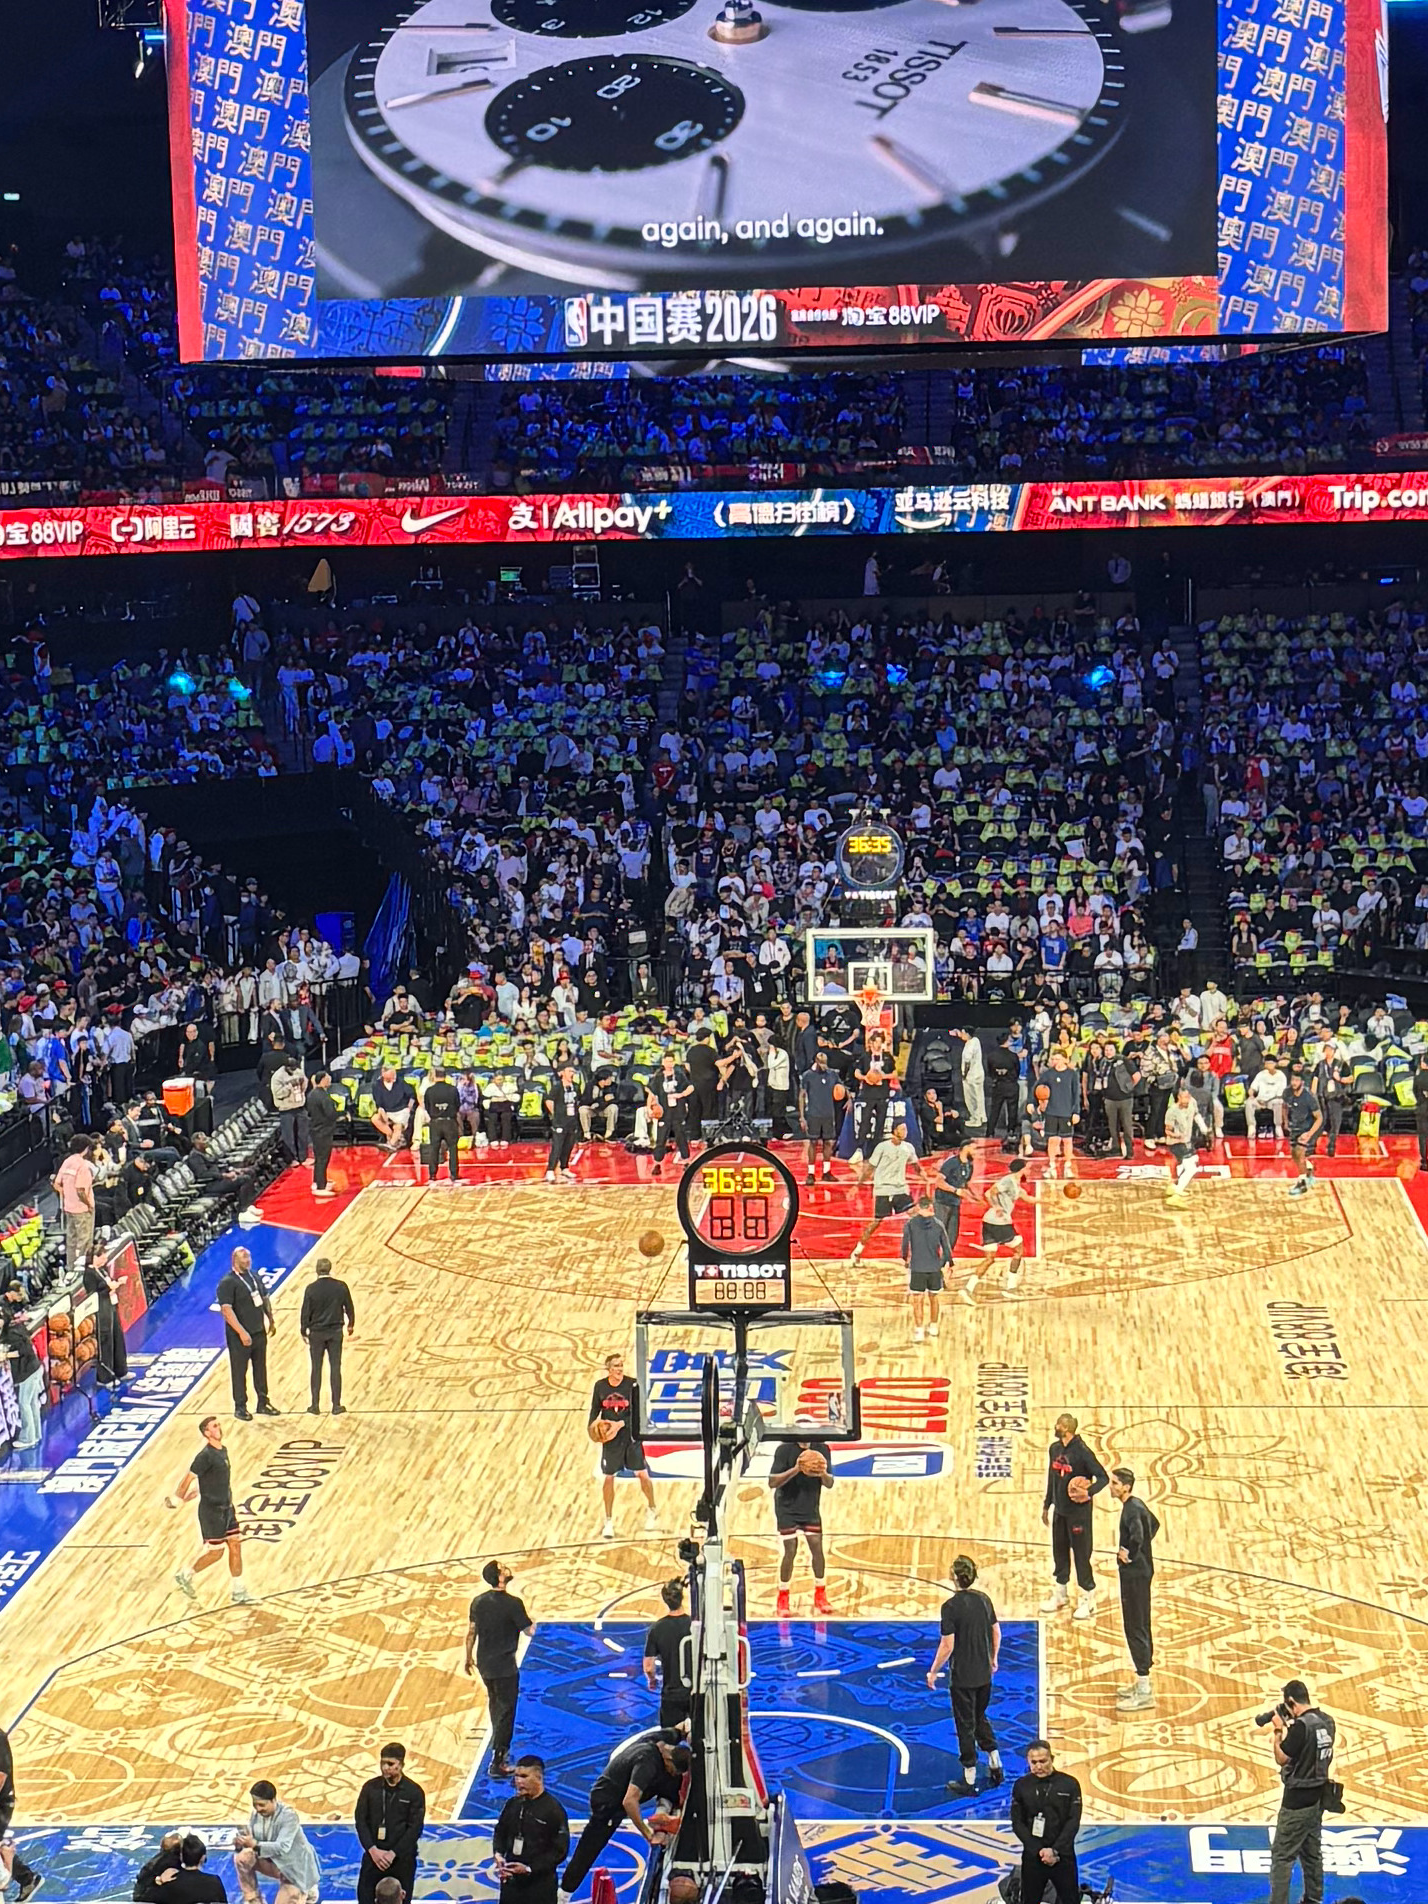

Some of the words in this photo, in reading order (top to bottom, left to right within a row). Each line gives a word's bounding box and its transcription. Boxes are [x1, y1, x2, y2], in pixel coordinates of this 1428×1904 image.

[224, 21, 286, 67] 澳門
[1224, 15, 1291, 63] 澳門
[195, 51, 242, 95] 澳門
[842, 48, 898, 83] 1853
[856, 40, 968, 120] TISSOT
[1253, 63, 1316, 111] 澳門
[212, 95, 270, 140] 澳門
[1282, 111, 1338, 161] 澳門
[238, 141, 301, 189] 澳門
[1231, 137, 1298, 188] 澳門
[203, 169, 254, 214] 澳門
[1262, 186, 1324, 234] 澳門
[225, 215, 284, 261] 澳門
[642, 215, 728, 247] again,
[735, 212, 790, 239] and
[797, 211, 885, 243] again.
[1217, 211, 1279, 259] 澳門
[200, 242, 239, 288] 澳門
[1289, 233, 1343, 282] 澳門
[250, 262, 314, 308] 澳門
[1242, 260, 1305, 308] 澳門
[216, 288, 267, 335] 澳門
[1049, 489, 1098, 512] ANT
[1100, 494, 1166, 512] BANK
[143, 515, 197, 542] 阿里云
[848, 836, 892, 853] 36:35
[702, 1166, 775, 1194] 36:35
[721, 1263, 787, 1279] TISSOT
